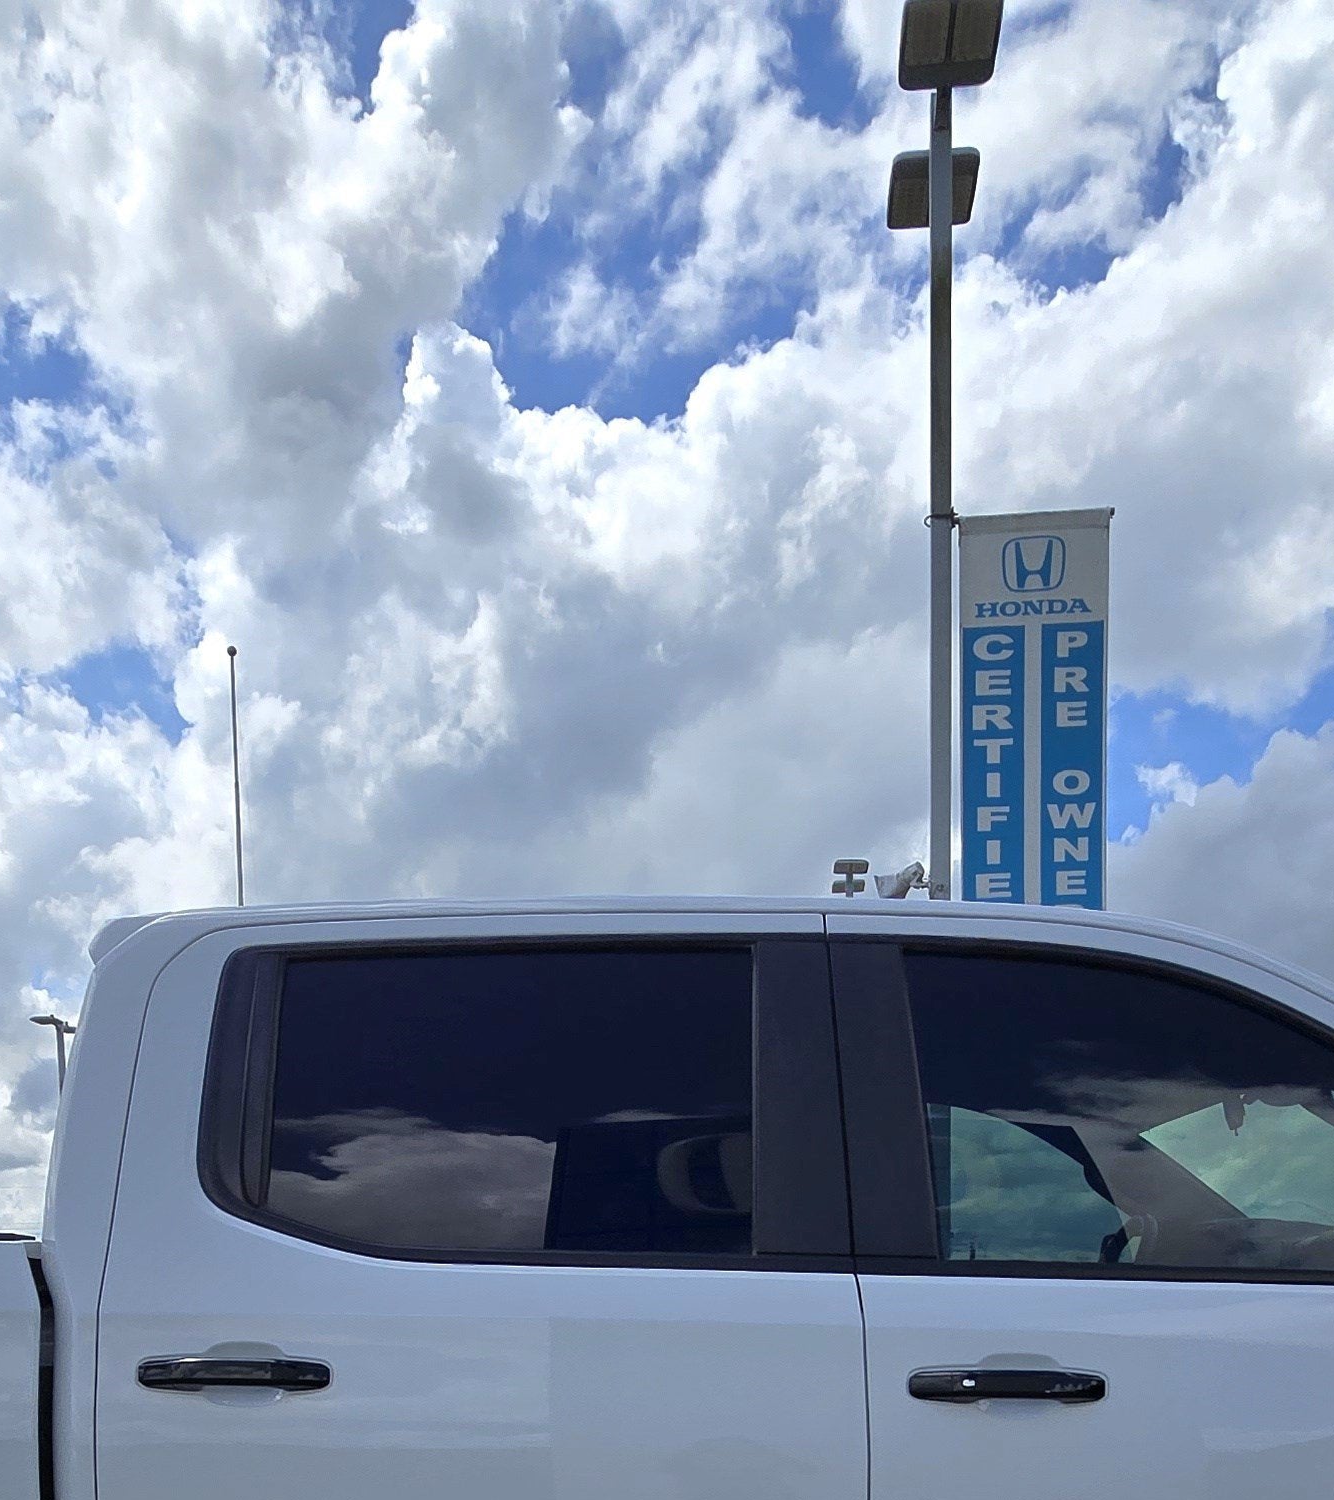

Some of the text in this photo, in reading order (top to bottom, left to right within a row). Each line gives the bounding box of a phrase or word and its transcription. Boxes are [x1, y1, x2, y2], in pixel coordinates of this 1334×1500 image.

[975, 598, 1091, 618] HONDA
[1047, 630, 1094, 907] PRE OWNE
